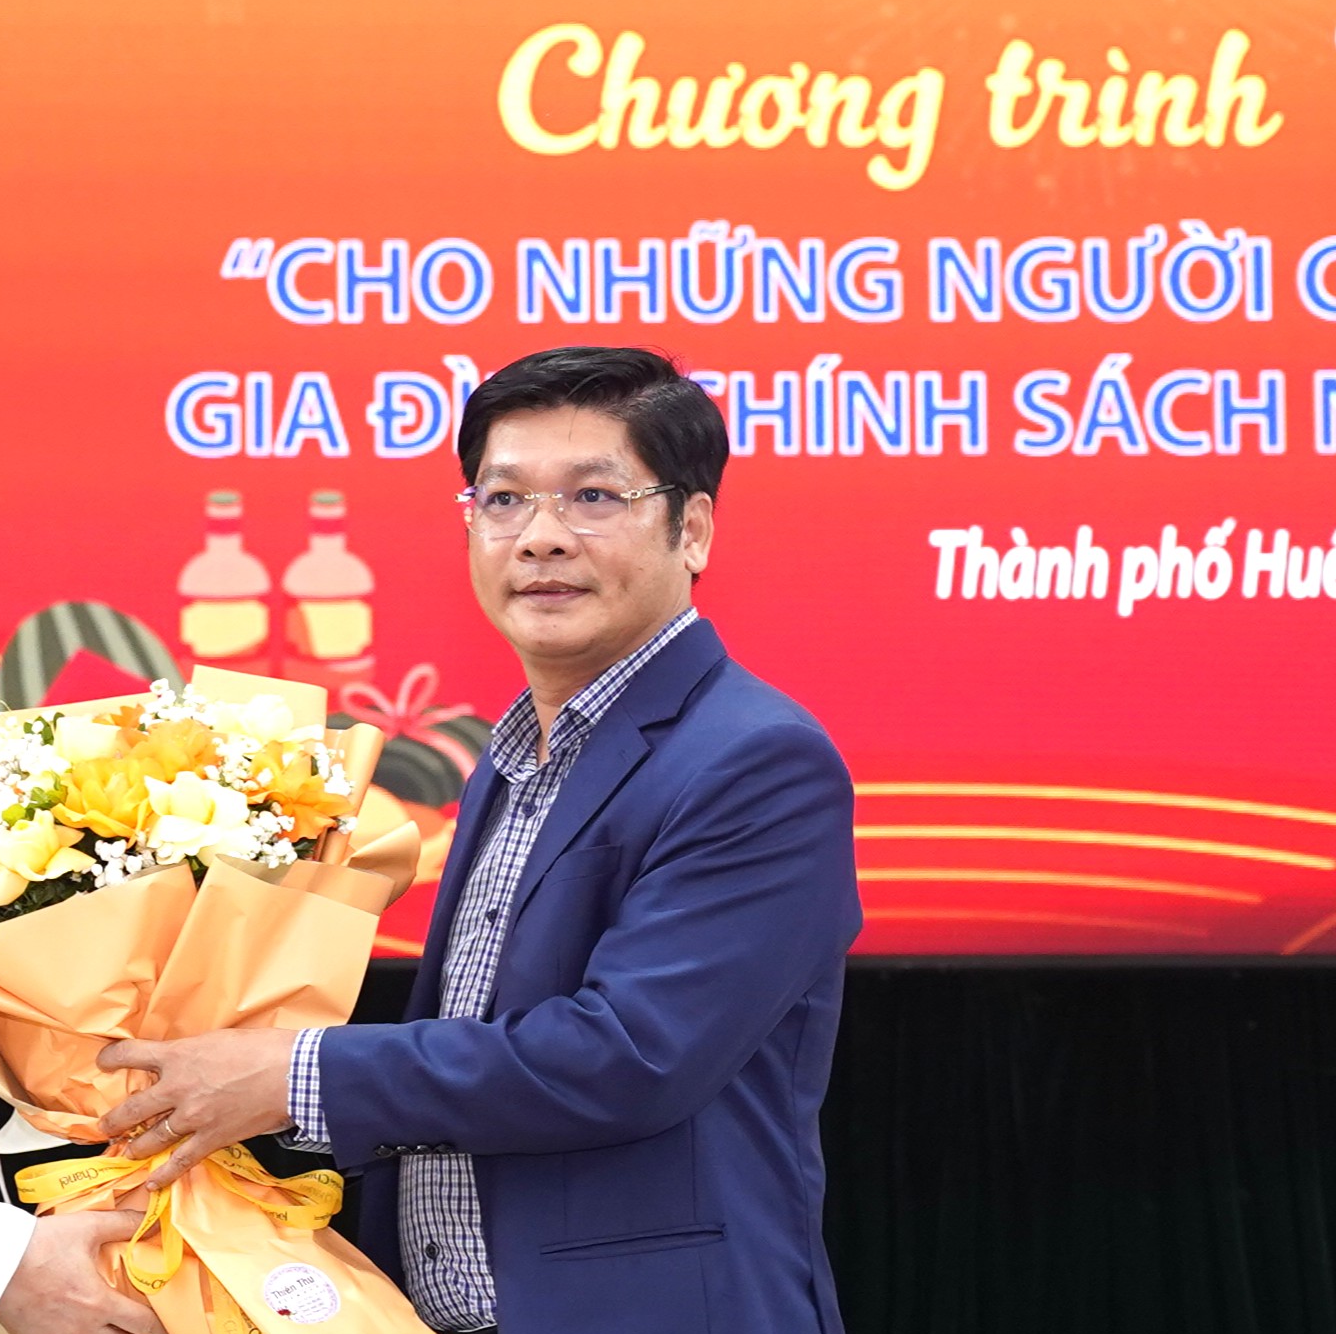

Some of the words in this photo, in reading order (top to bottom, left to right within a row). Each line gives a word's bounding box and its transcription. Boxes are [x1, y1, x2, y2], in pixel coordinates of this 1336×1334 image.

[497, 22, 947, 192] Chương
[985, 28, 1285, 149] trình
[515, 218, 905, 327] NHỮNG
[927, 218, 1275, 323] NGƯỜI
[164, 371, 350, 459] GIA
[688, 352, 989, 459] HÍNH
[1011, 352, 1287, 458] SÁCH
[927, 524, 1111, 601] Thành
[1116, 517, 1238, 619] phố
